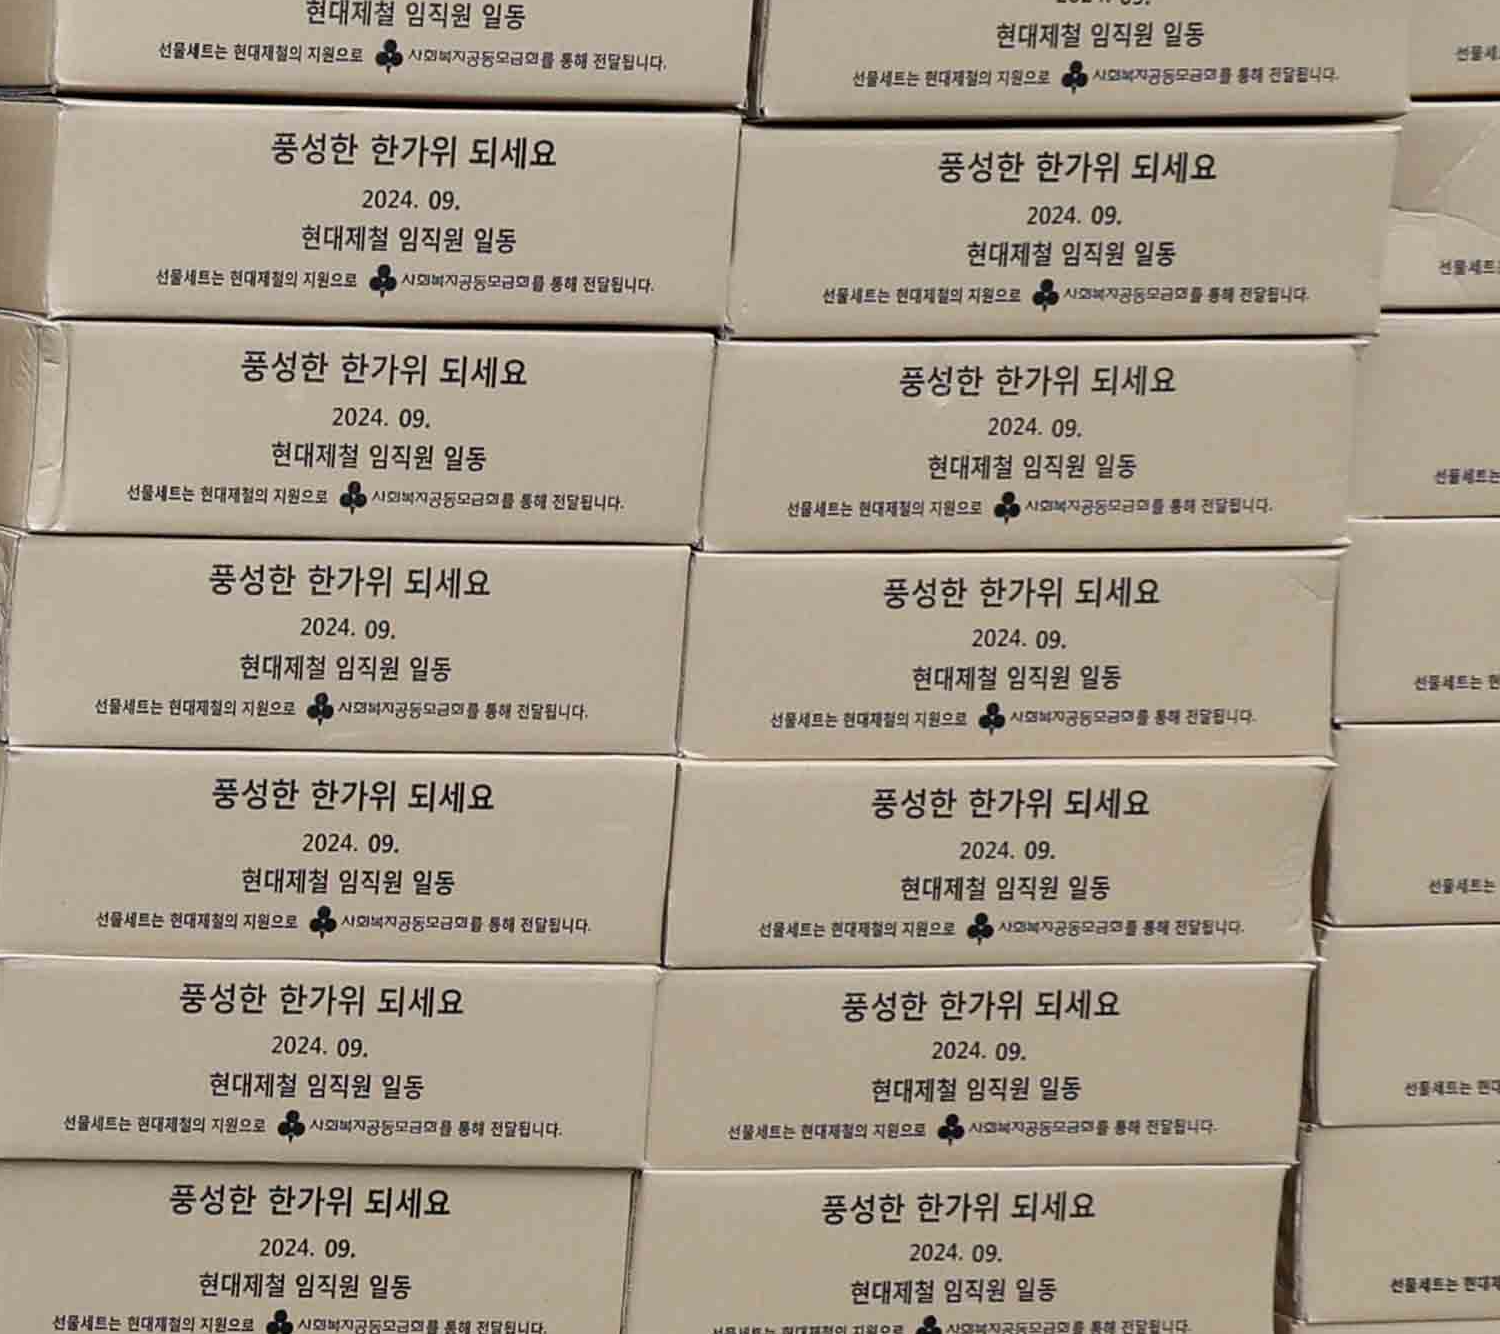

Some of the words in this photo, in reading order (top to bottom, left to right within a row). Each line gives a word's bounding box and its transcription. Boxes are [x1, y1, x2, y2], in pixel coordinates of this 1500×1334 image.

[270, 131, 360, 166] 풍성한
[371, 133, 458, 170] 한가위
[467, 135, 557, 171] 되세요
[361, 188, 419, 210] 2024.
[428, 189, 461, 212] 09.
[301, 223, 389, 252] 현대제철
[398, 226, 464, 254] 임직원
[473, 226, 517, 255] 일동
[155, 268, 225, 287] 선물세트는
[229, 269, 298, 289] 현대제철의
[302, 270, 357, 290] 지원으로
[549, 275, 578, 294] 통해
[582, 275, 655, 295] 전달됩니다.
